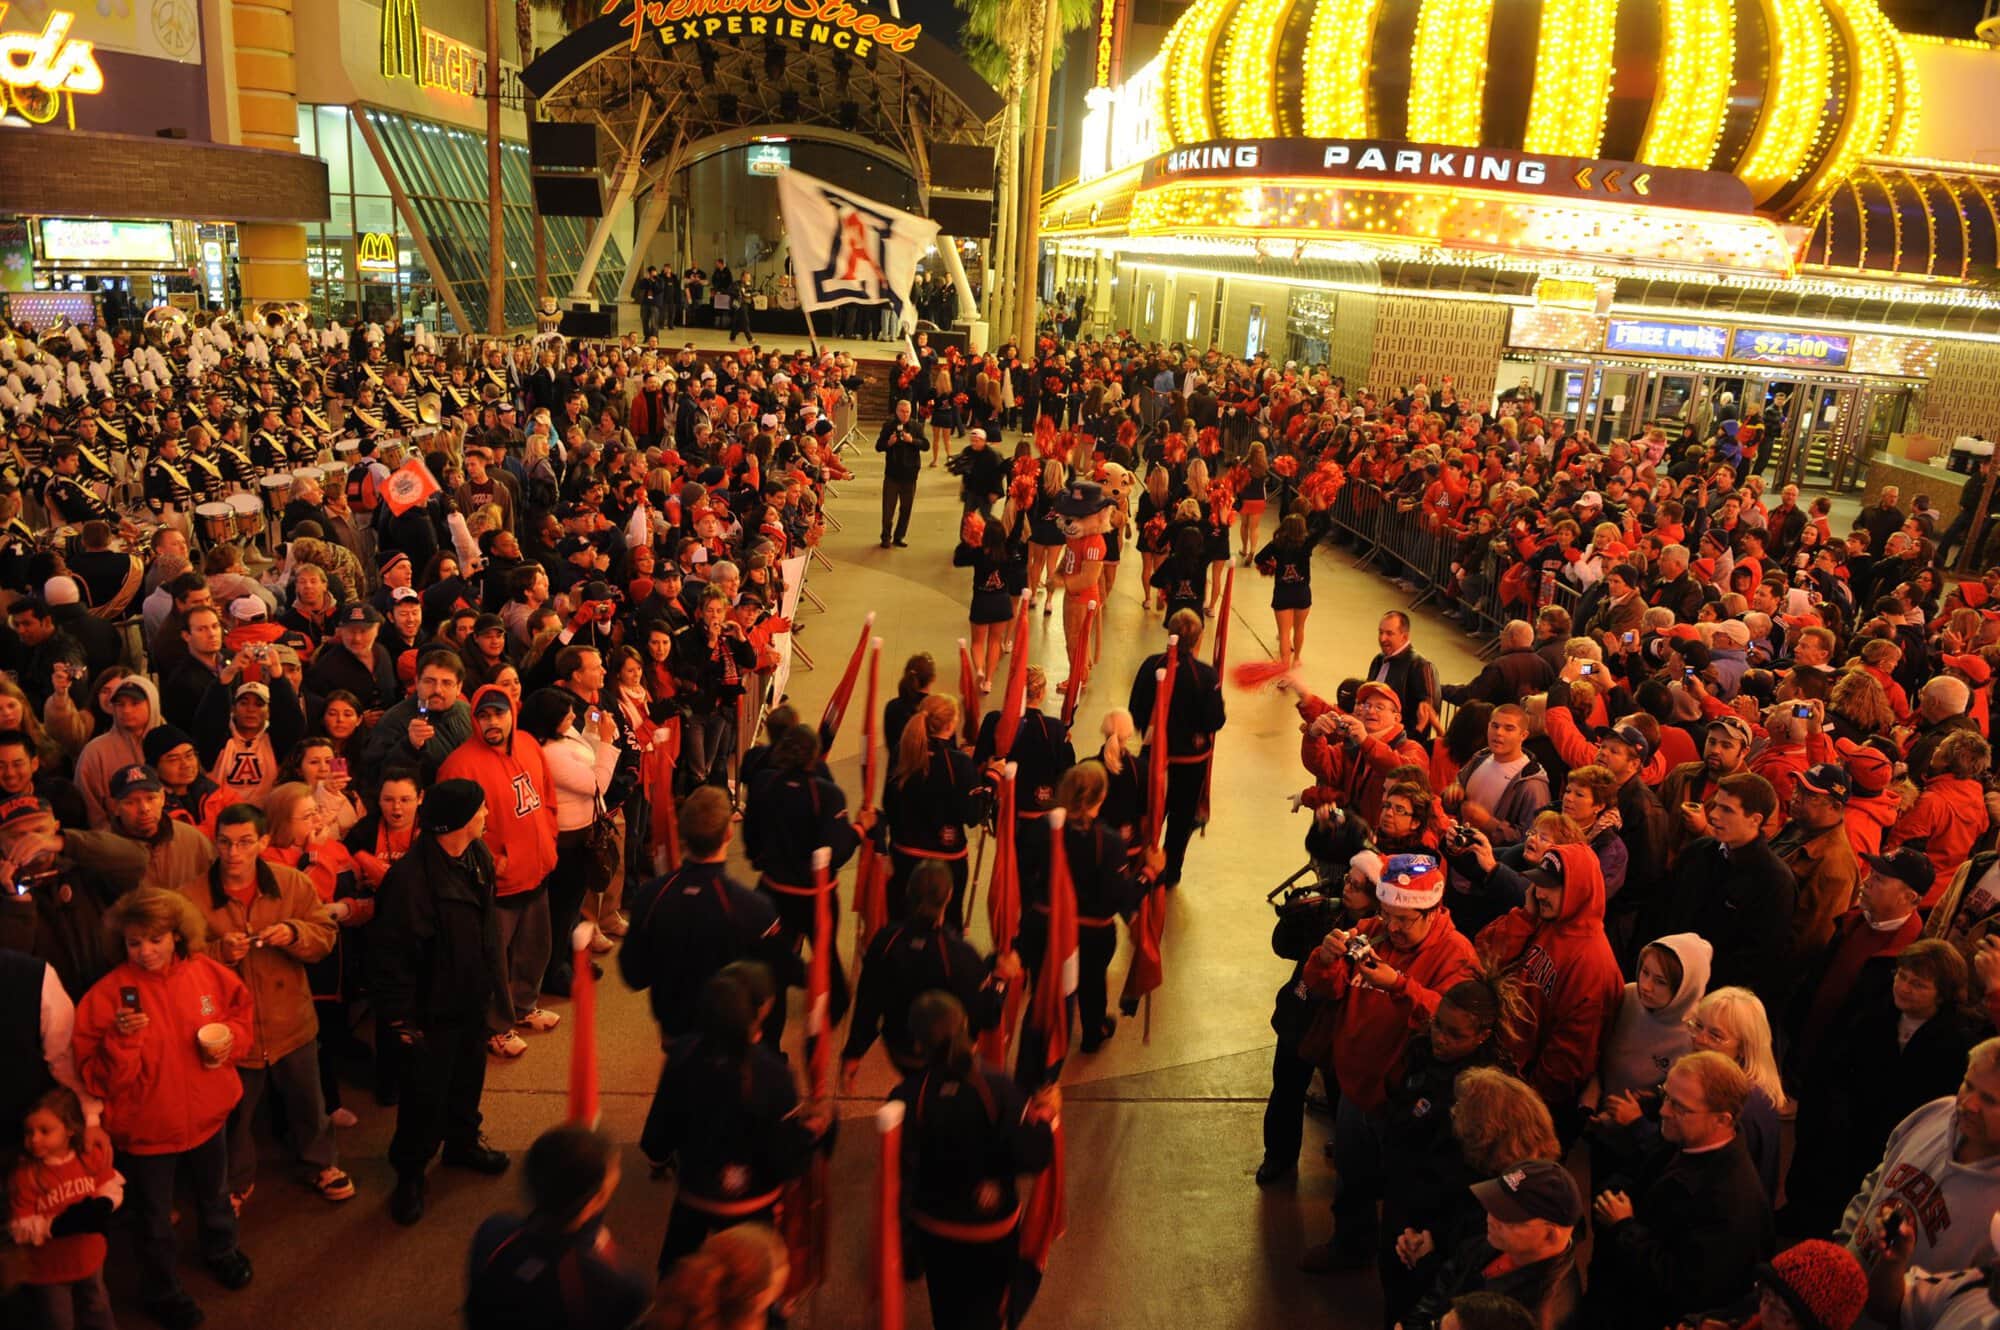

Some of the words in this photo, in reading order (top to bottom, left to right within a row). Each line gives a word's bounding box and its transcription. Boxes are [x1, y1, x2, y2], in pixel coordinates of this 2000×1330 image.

[600, 0, 783, 51] Fremont
[784, 0, 922, 52] Street
[659, 16, 873, 58] EXPERIENCE
[1323, 146, 1547, 185] PARKING
[1615, 324, 1665, 346] FREE
[1754, 335, 1829, 358] $2,500
[227, 752, 263, 785] A
